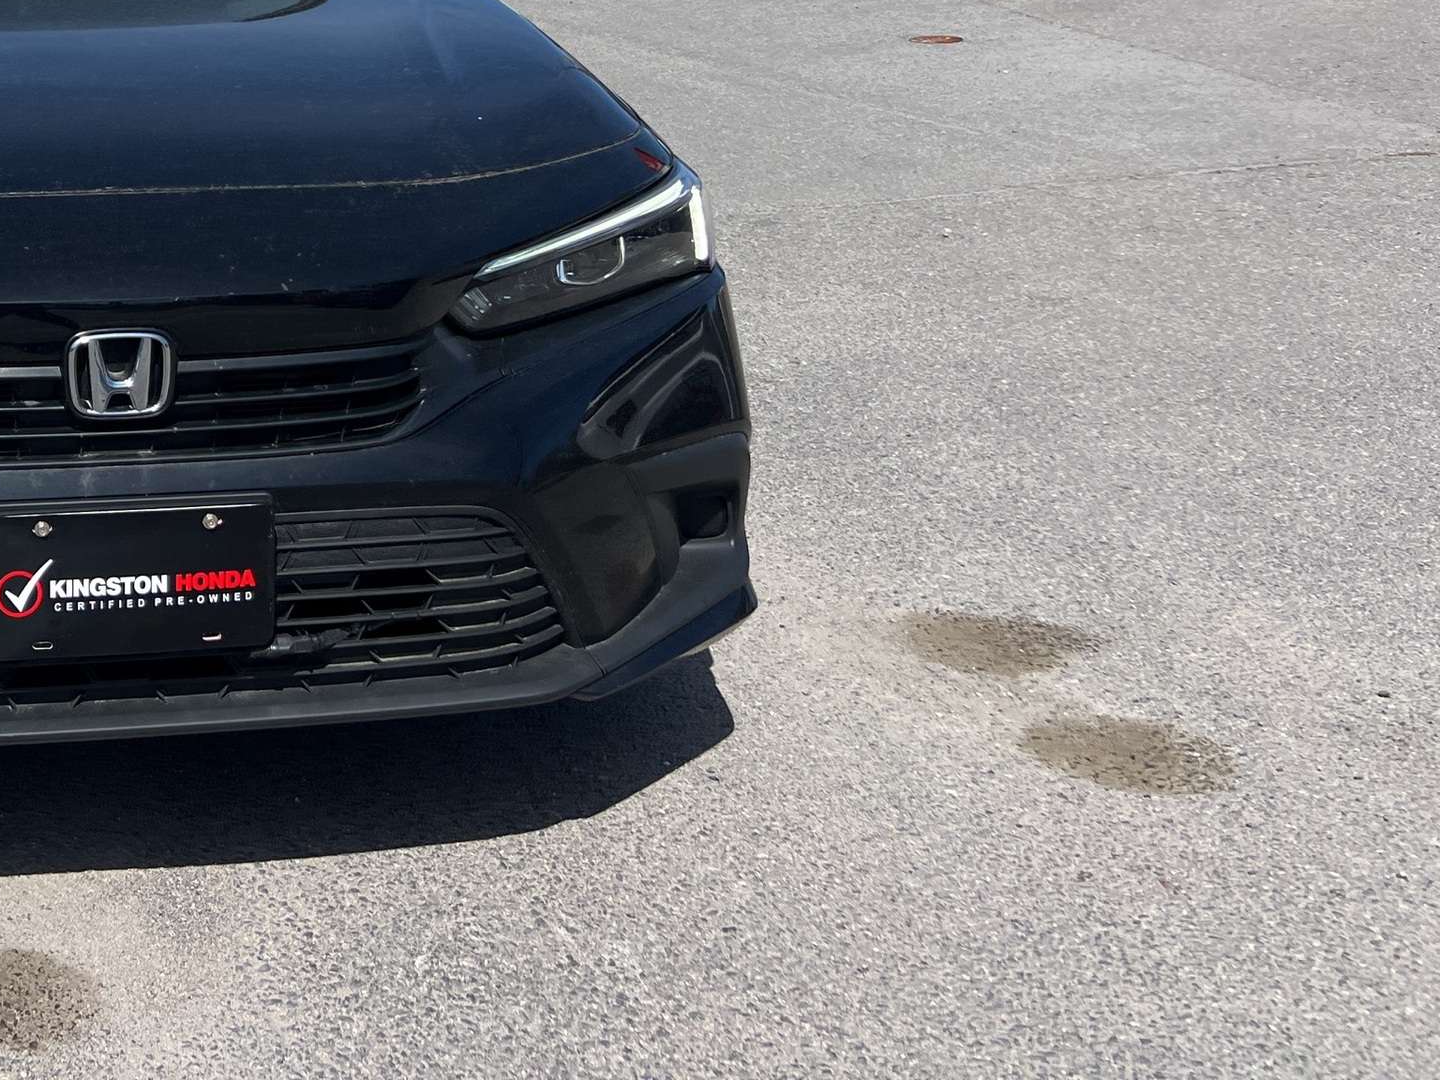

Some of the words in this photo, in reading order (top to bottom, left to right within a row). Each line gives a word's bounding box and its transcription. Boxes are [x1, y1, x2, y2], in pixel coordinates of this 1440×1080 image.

[49, 574, 168, 599] KINGSTON
[175, 569, 256, 592] HONDA
[54, 599, 146, 612] CERTIFIED
[155, 591, 253, 607] PRE-OWNED
